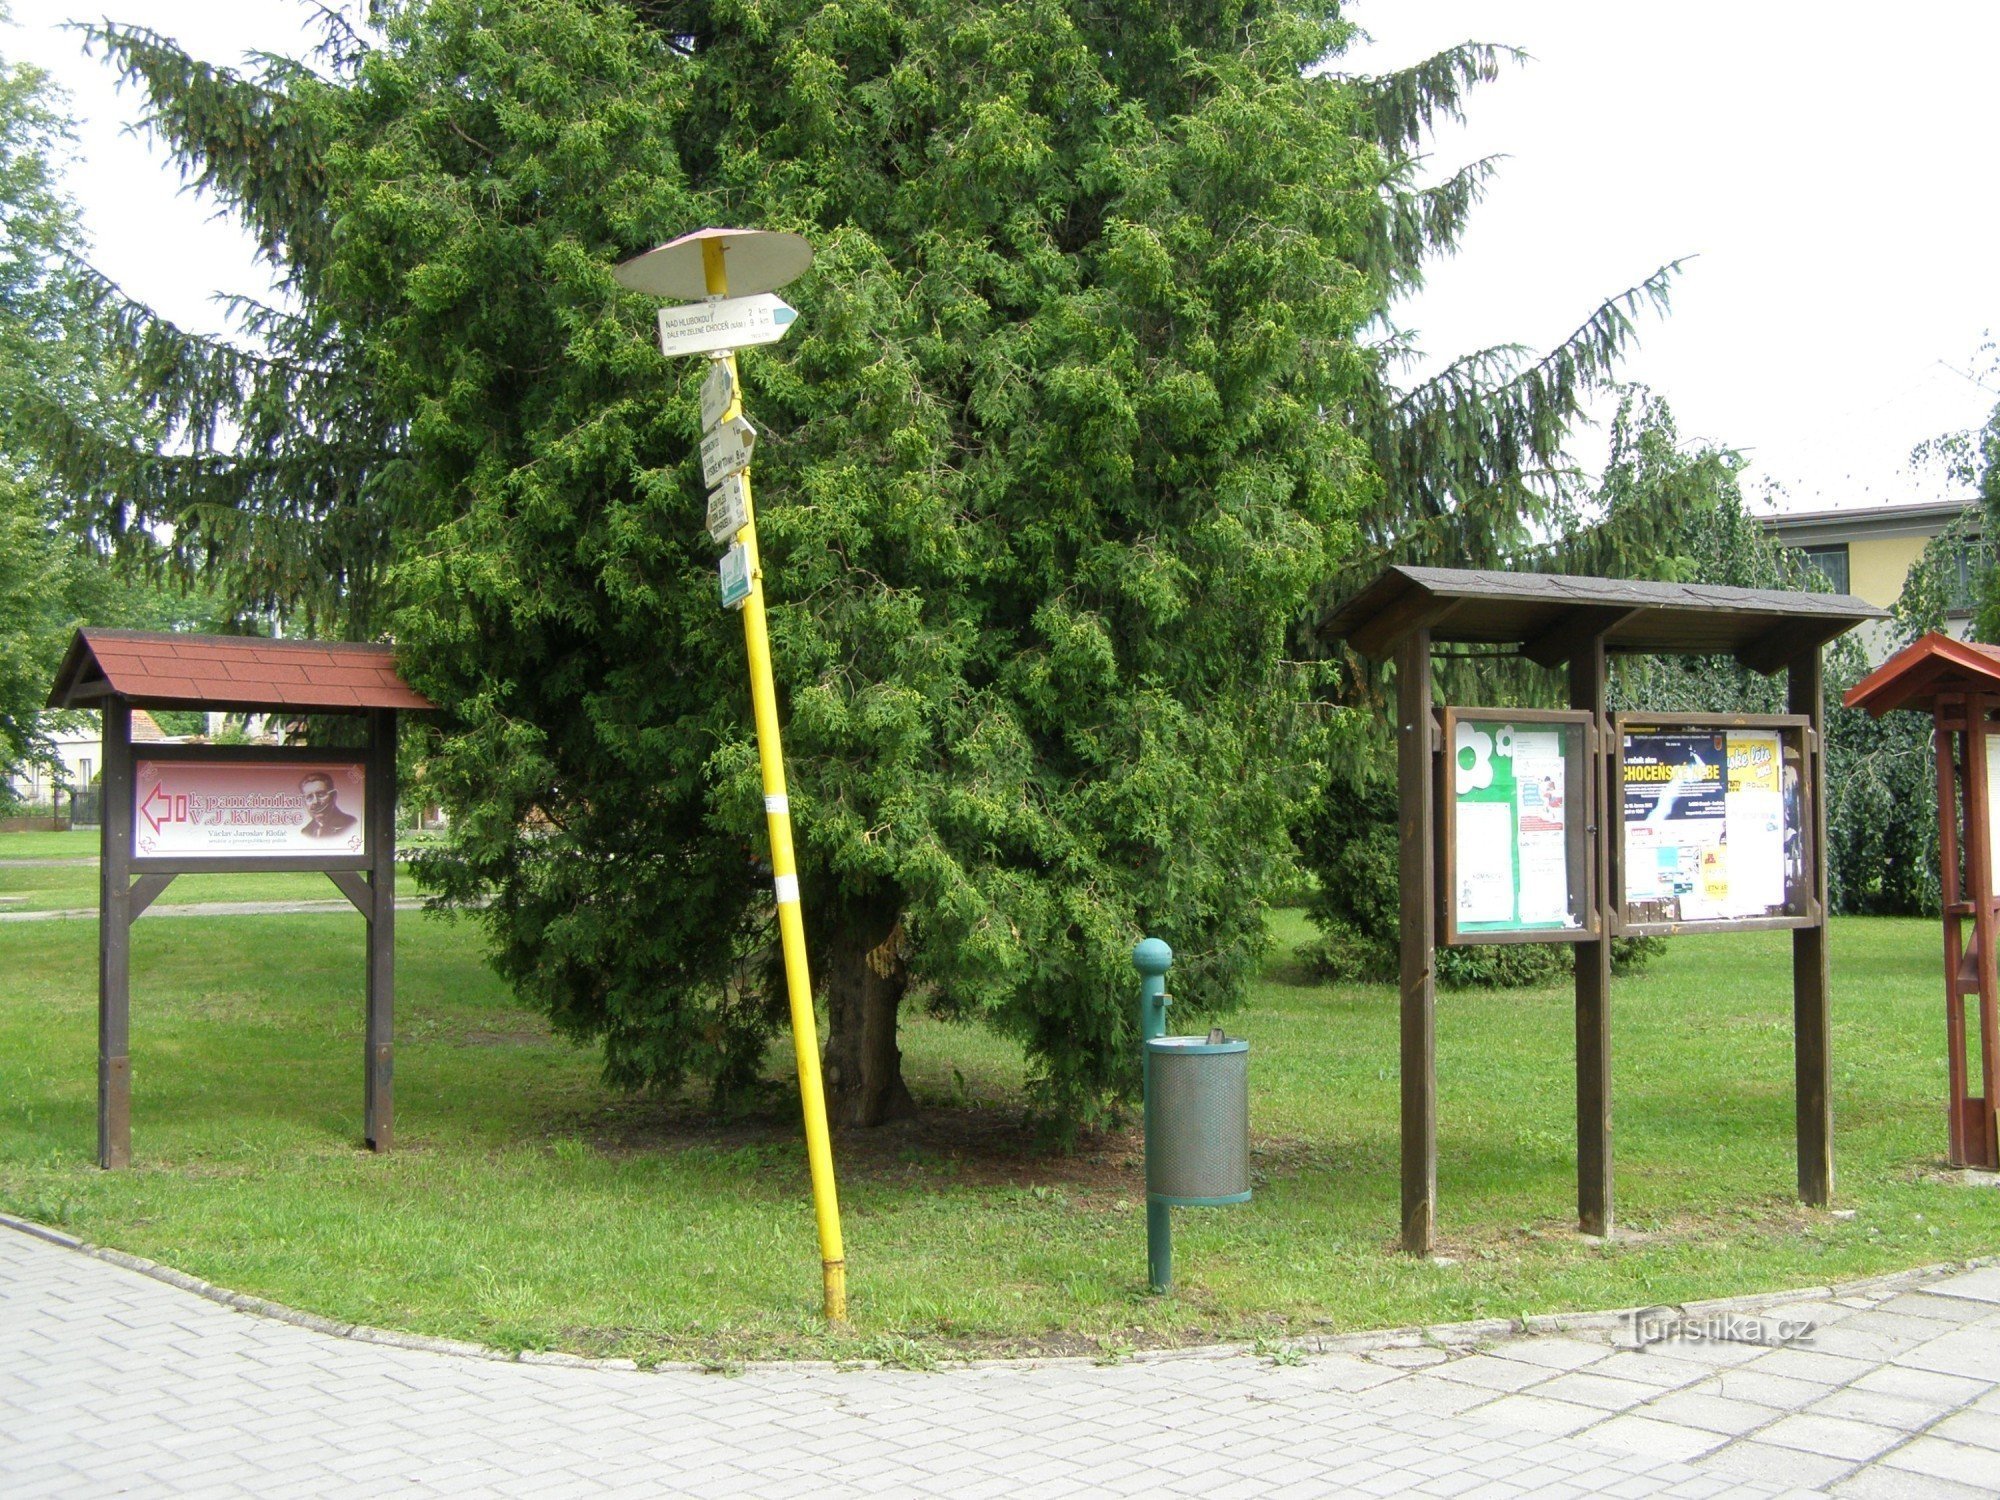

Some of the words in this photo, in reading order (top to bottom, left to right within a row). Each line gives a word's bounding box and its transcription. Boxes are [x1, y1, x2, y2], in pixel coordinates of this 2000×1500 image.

[665, 319, 679, 329] NAD
[706, 320, 730, 333] CHOCEŇ
[189, 792, 202, 808] k
[206, 792, 303, 813] památníku
